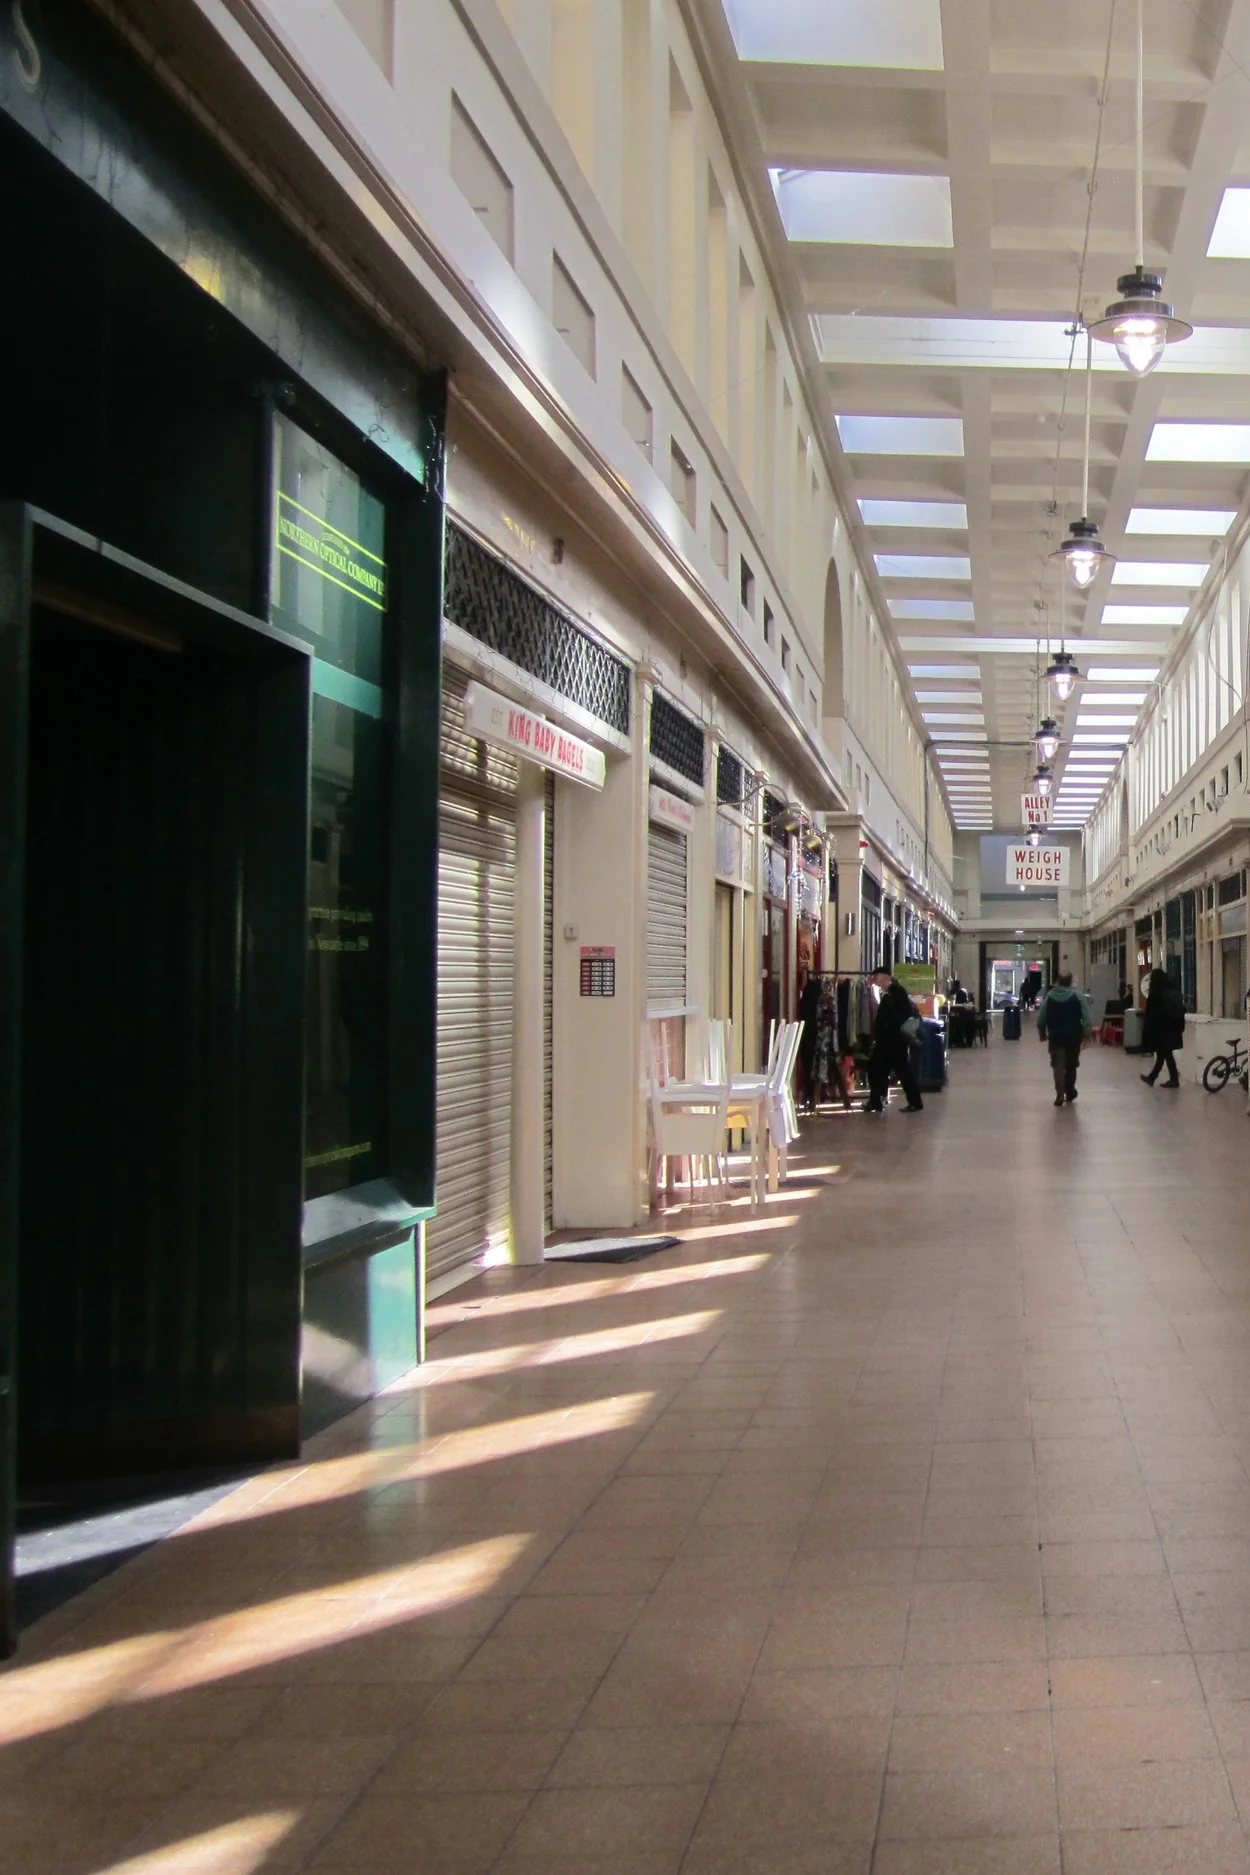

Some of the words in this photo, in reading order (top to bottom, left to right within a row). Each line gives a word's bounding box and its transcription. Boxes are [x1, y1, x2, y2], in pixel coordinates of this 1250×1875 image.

[279, 517, 319, 555] NORTHERN
[320, 542, 347, 574] OPTICAL
[348, 561, 377, 592] COMPANY
[508, 710, 531, 745] KING
[534, 722, 556, 759] BABY
[557, 736, 584, 772] BAGELS
[1024, 796, 1050, 809] ALLEY
[1028, 810, 1041, 823] No
[1015, 850, 1061, 864] WEIGH
[1016, 867, 1061, 881] HOUSE
